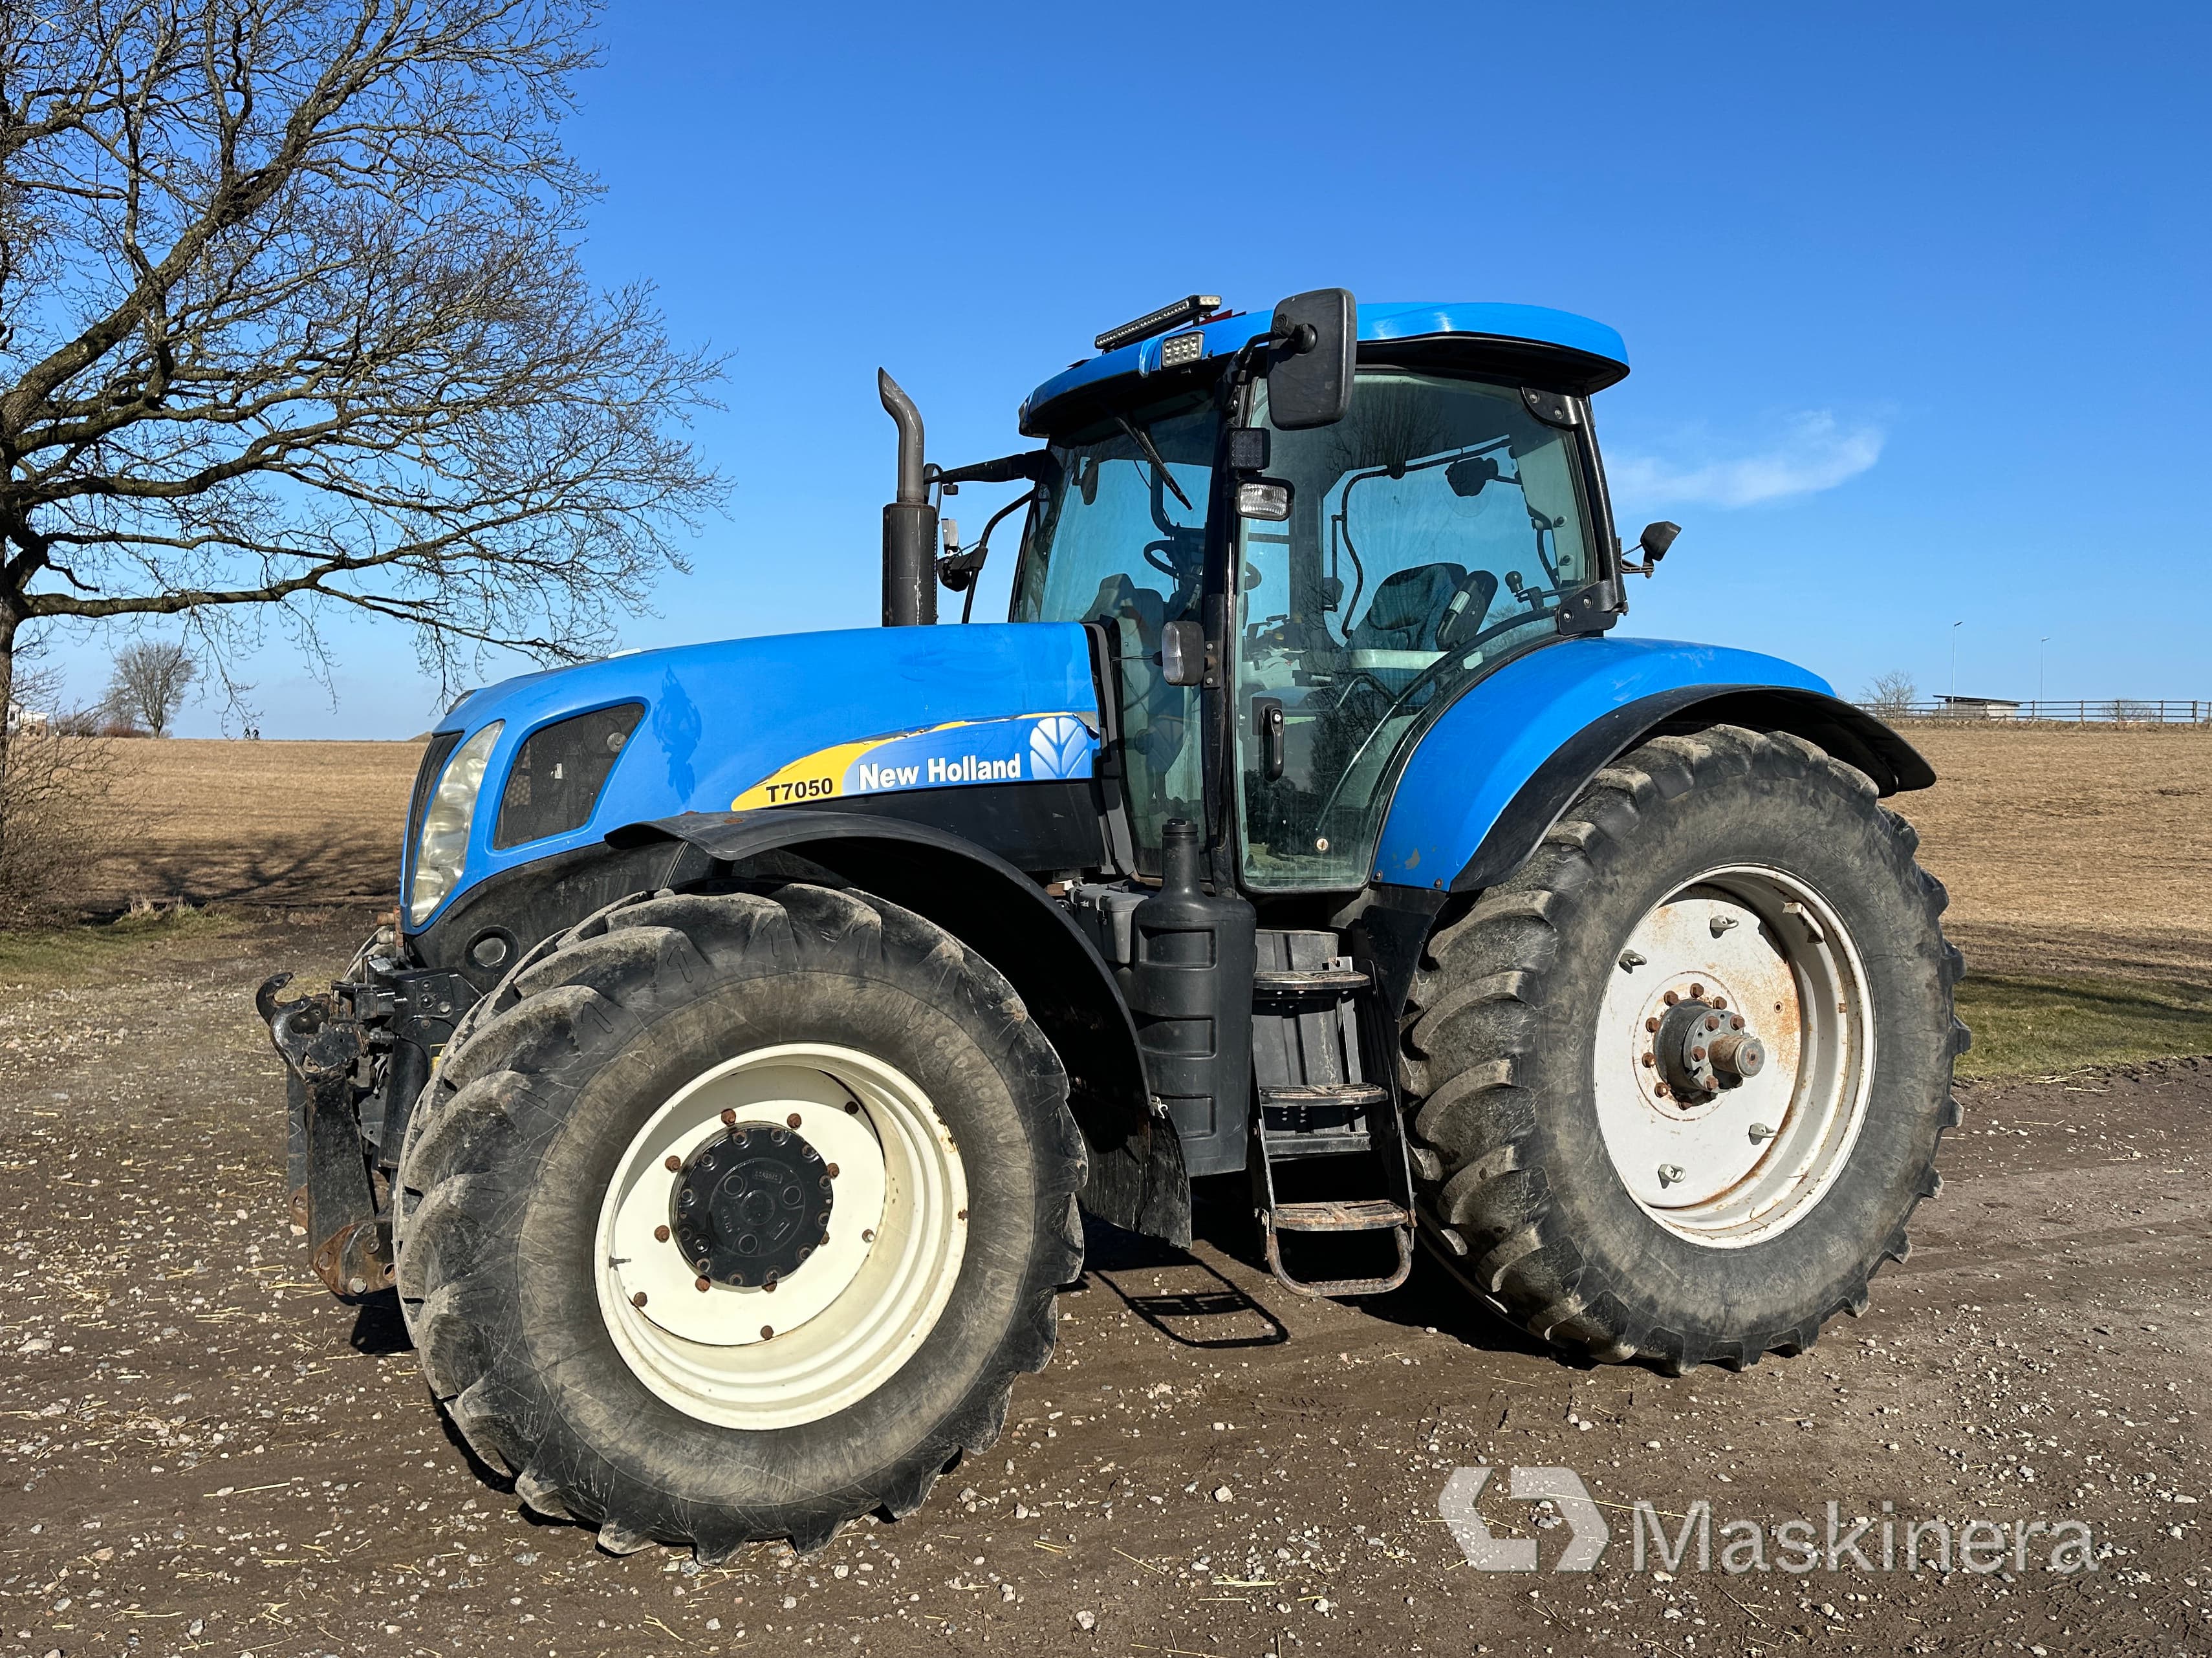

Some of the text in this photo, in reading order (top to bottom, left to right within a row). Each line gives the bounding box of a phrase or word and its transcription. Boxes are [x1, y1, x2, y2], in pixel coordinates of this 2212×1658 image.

[859, 753, 1021, 791] New Holland
[766, 778, 833, 802] T7050
